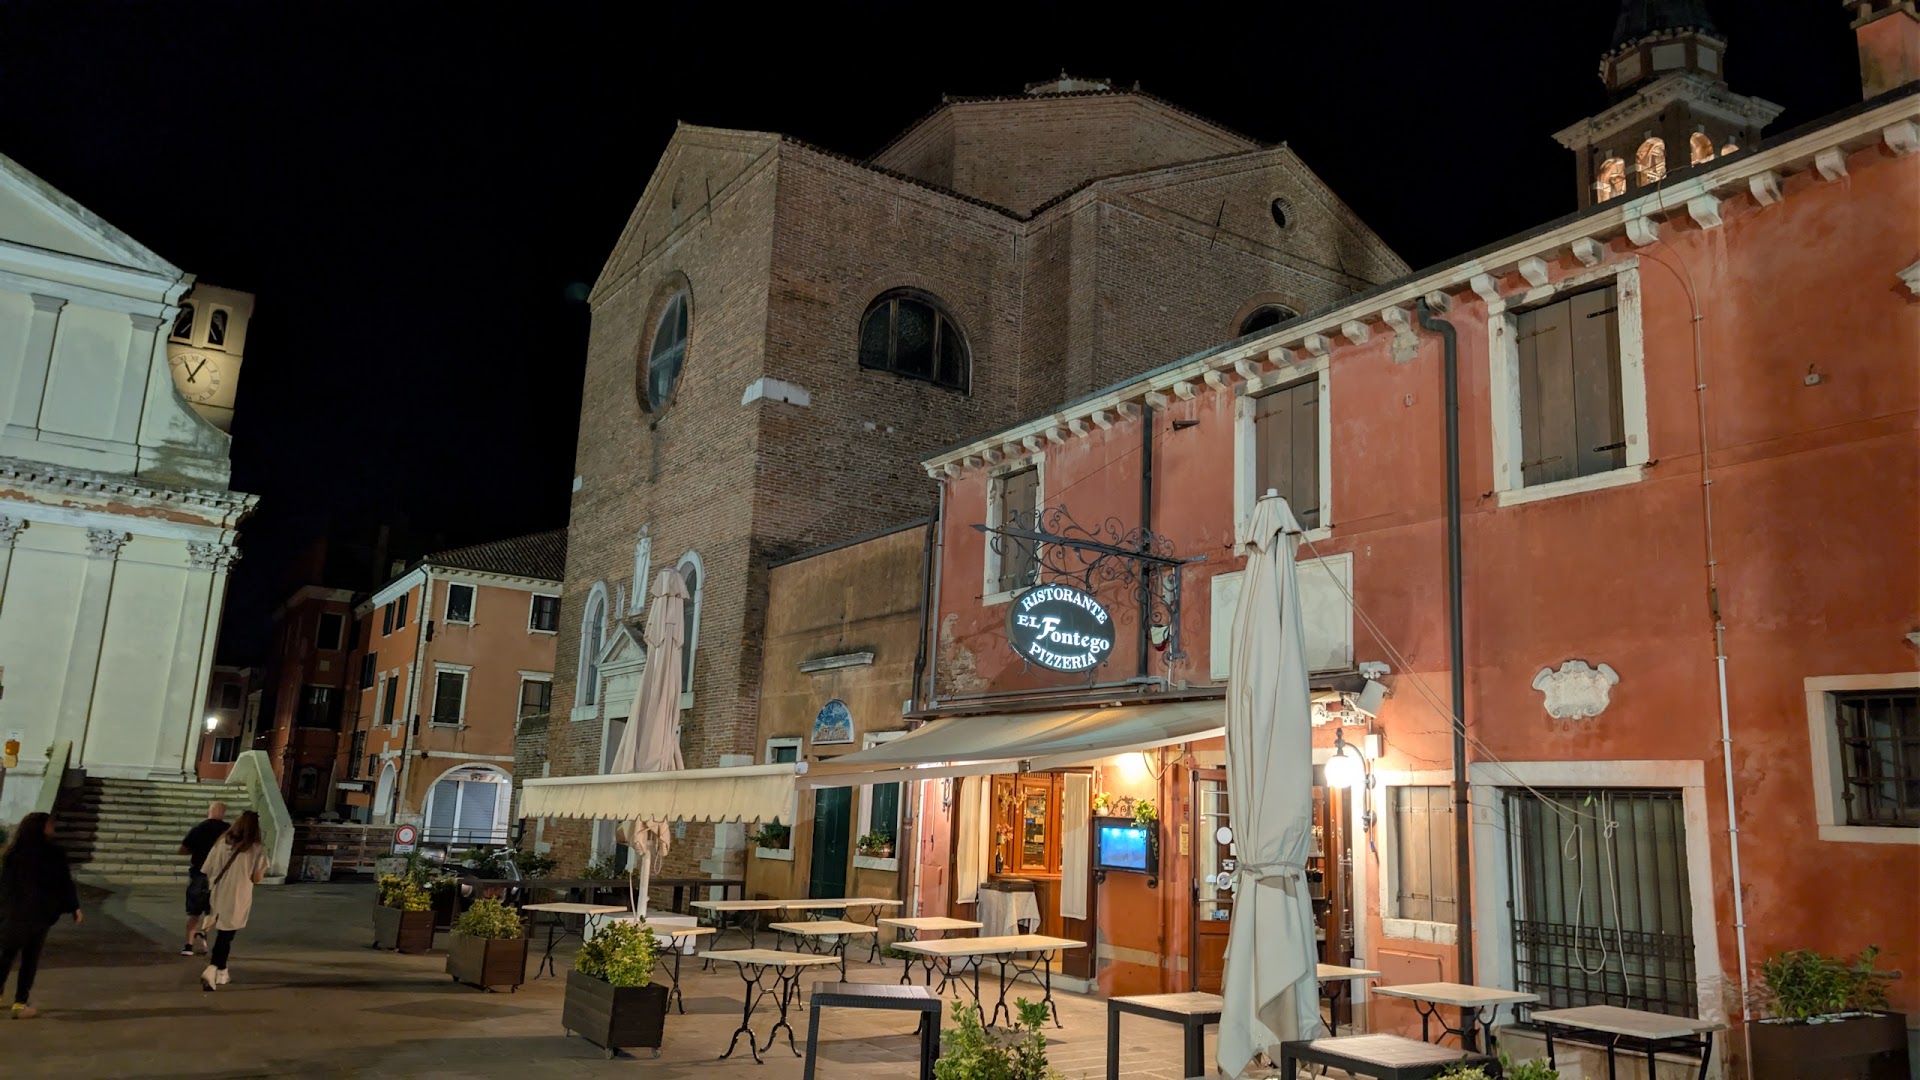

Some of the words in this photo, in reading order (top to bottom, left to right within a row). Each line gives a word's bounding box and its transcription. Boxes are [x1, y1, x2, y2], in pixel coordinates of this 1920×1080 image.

[1021, 588, 1107, 624] RISTORANTE
[1017, 614, 1041, 629] EL
[1036, 617, 1110, 653] Fontego
[1029, 642, 1097, 669] PIZZERIA
